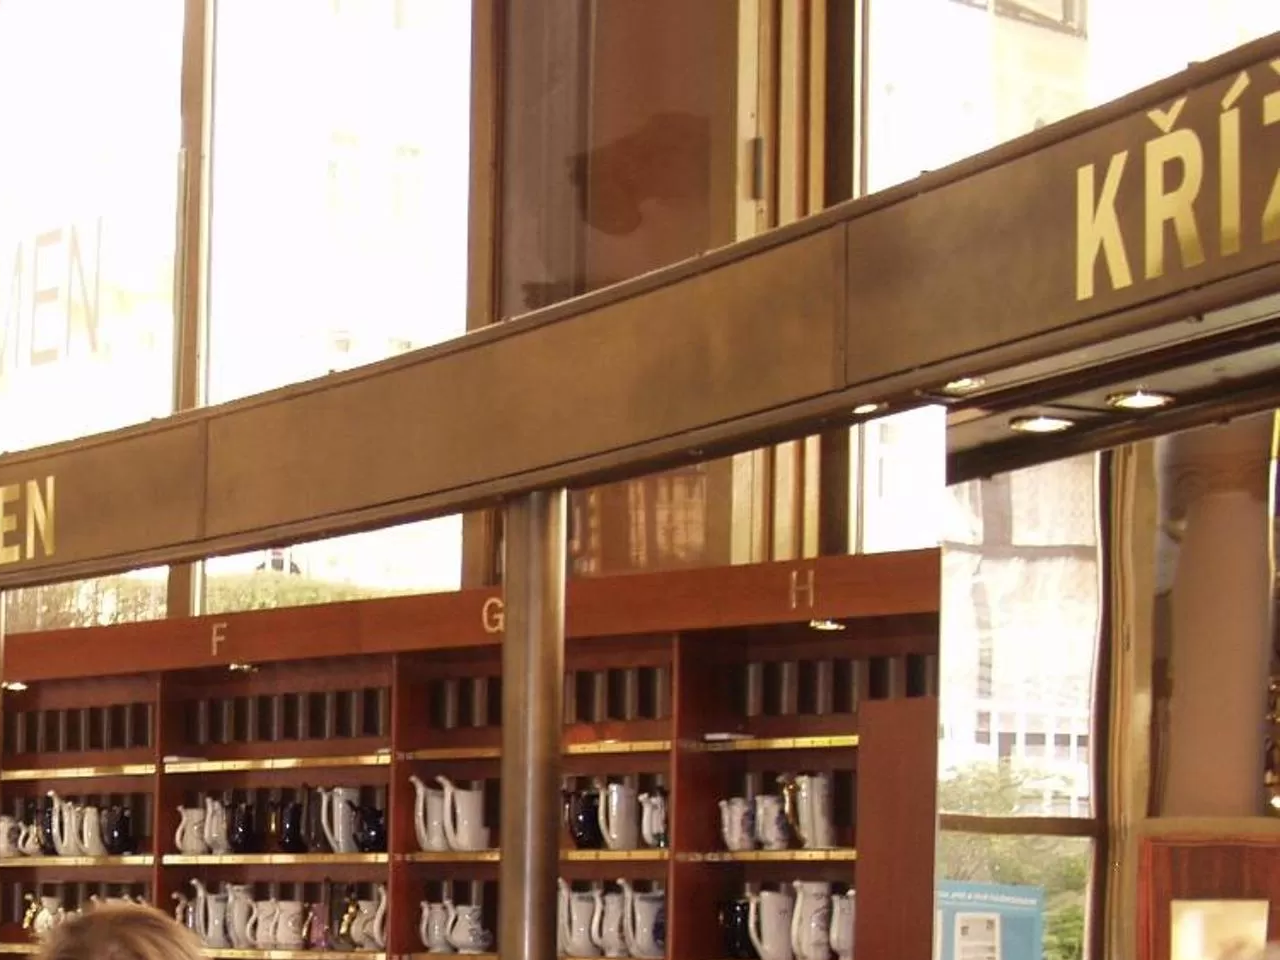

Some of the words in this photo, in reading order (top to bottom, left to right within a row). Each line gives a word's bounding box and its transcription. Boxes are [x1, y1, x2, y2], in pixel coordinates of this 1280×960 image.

[791, 570, 815, 609] H
[481, 597, 505, 633] G
[210, 622, 228, 657] F
